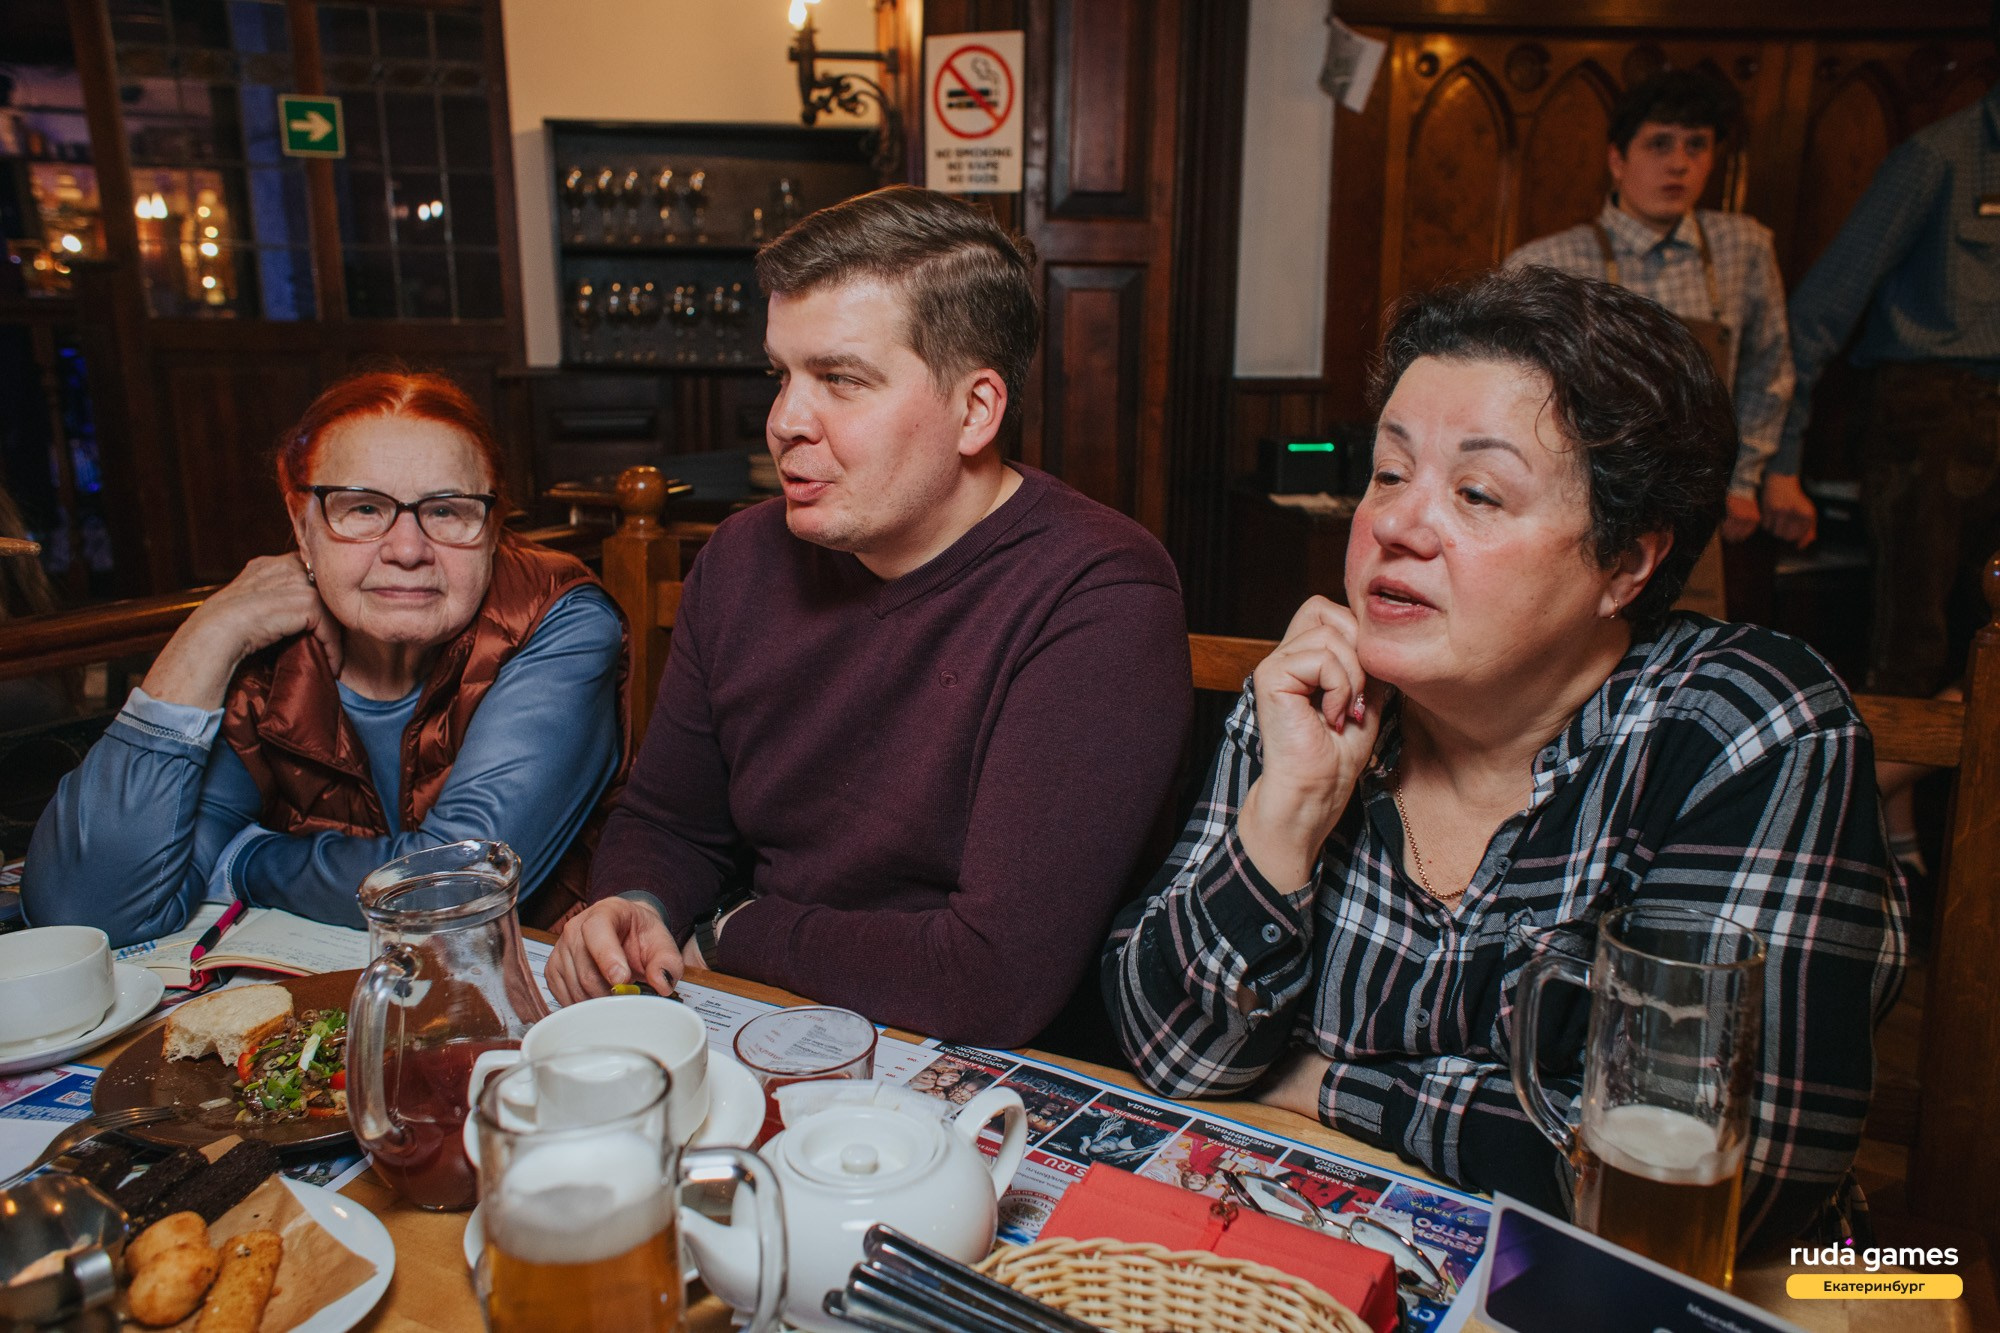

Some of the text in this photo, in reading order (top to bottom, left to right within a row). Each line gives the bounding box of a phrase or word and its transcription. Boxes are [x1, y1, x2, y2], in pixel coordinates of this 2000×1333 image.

[939, 1046, 1009, 1070] ЗОЛОТОЙ СОСТАВ
[1113, 1108, 1151, 1123] АПРЕЛЯ
[1127, 1101, 1163, 1116] ЛИНДА
[1204, 1123, 1275, 1150] ИМЕНИННИКА
[1221, 1135, 1251, 1147] ДЕНЬ
[1207, 1138, 1252, 1156] 29 МАРТА
[1044, 1157, 1088, 1178] S.RU
[1314, 1157, 1367, 1179] КОРОВКА
[1315, 1164, 1357, 1181] БОЖЬЯ
[1306, 1169, 1355, 1189] 26 МАРТА
[1410, 1200, 1452, 1219] МАРТА
[1415, 1217, 1484, 1246] РЕТРО
